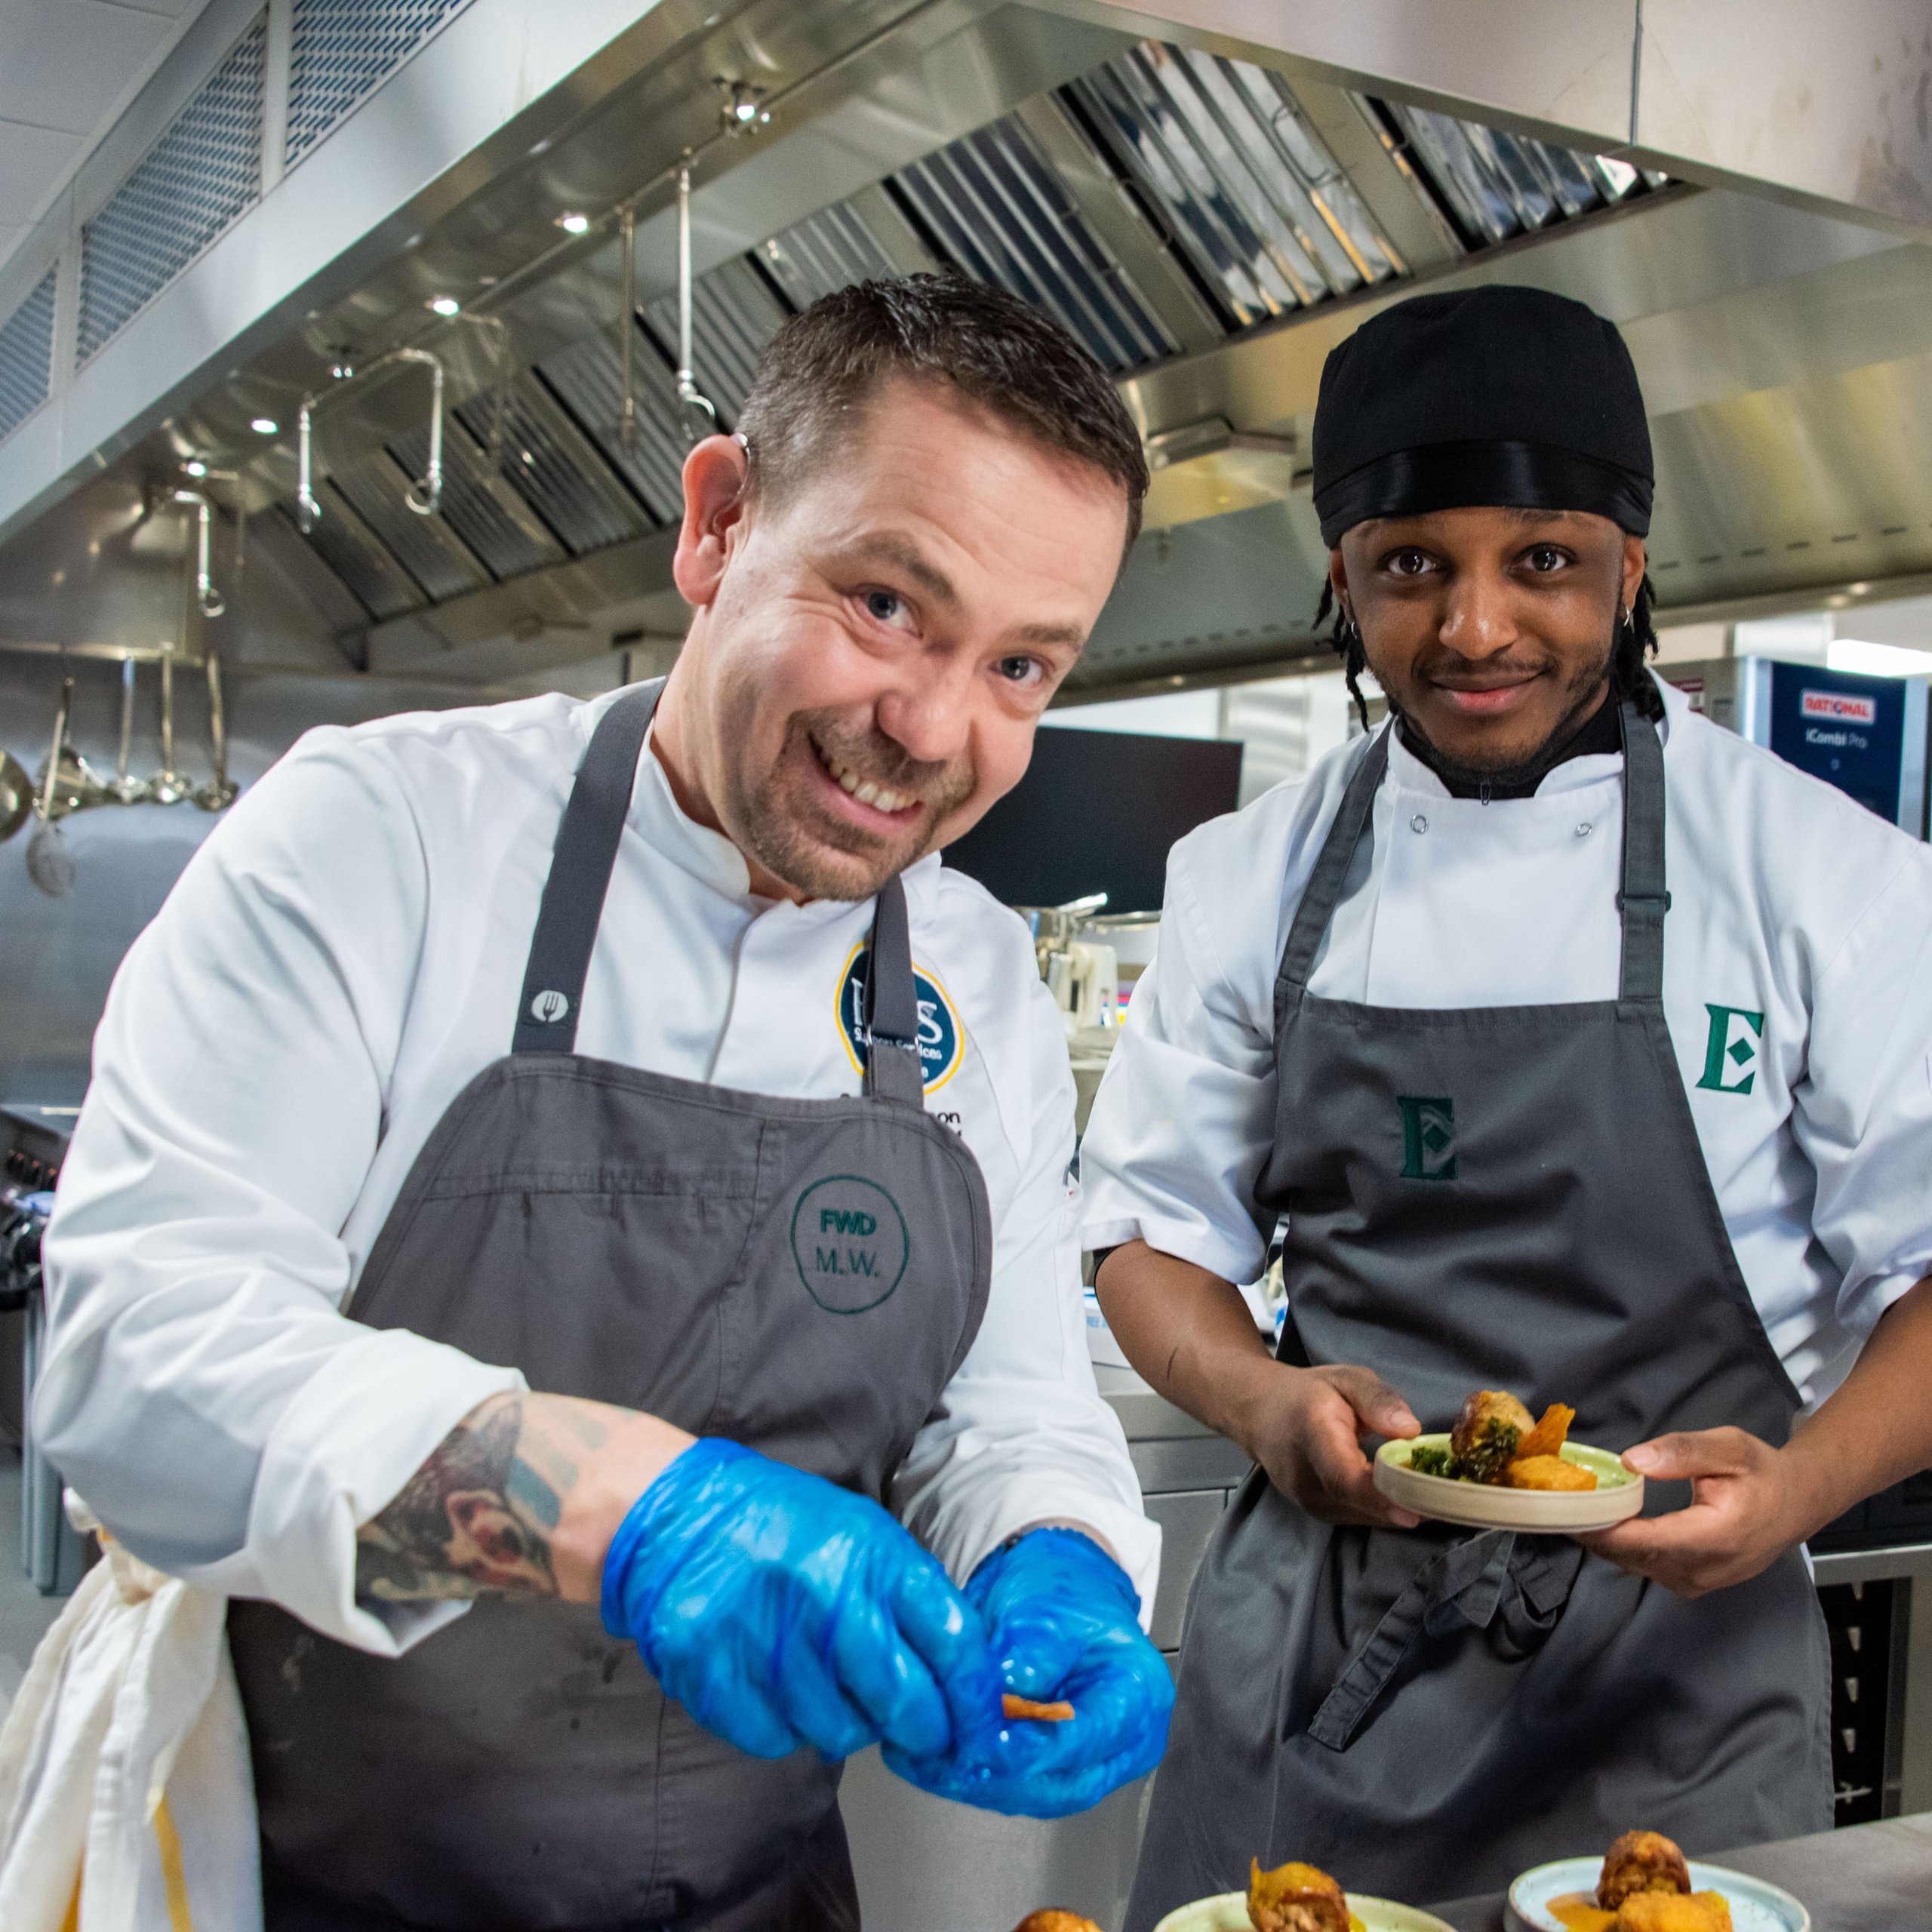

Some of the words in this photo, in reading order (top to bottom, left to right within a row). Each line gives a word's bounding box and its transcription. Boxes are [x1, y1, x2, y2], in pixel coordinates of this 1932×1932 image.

[1804, 697, 1869, 717] RATIONAL
[1806, 728, 1847, 746] iCombi
[1848, 732, 1869, 749] Pro
[1695, 1002, 1764, 1095] E
[937, 1112, 961, 1124] on
[1396, 1095, 1458, 1180] E
[820, 1208, 877, 1236] FWD
